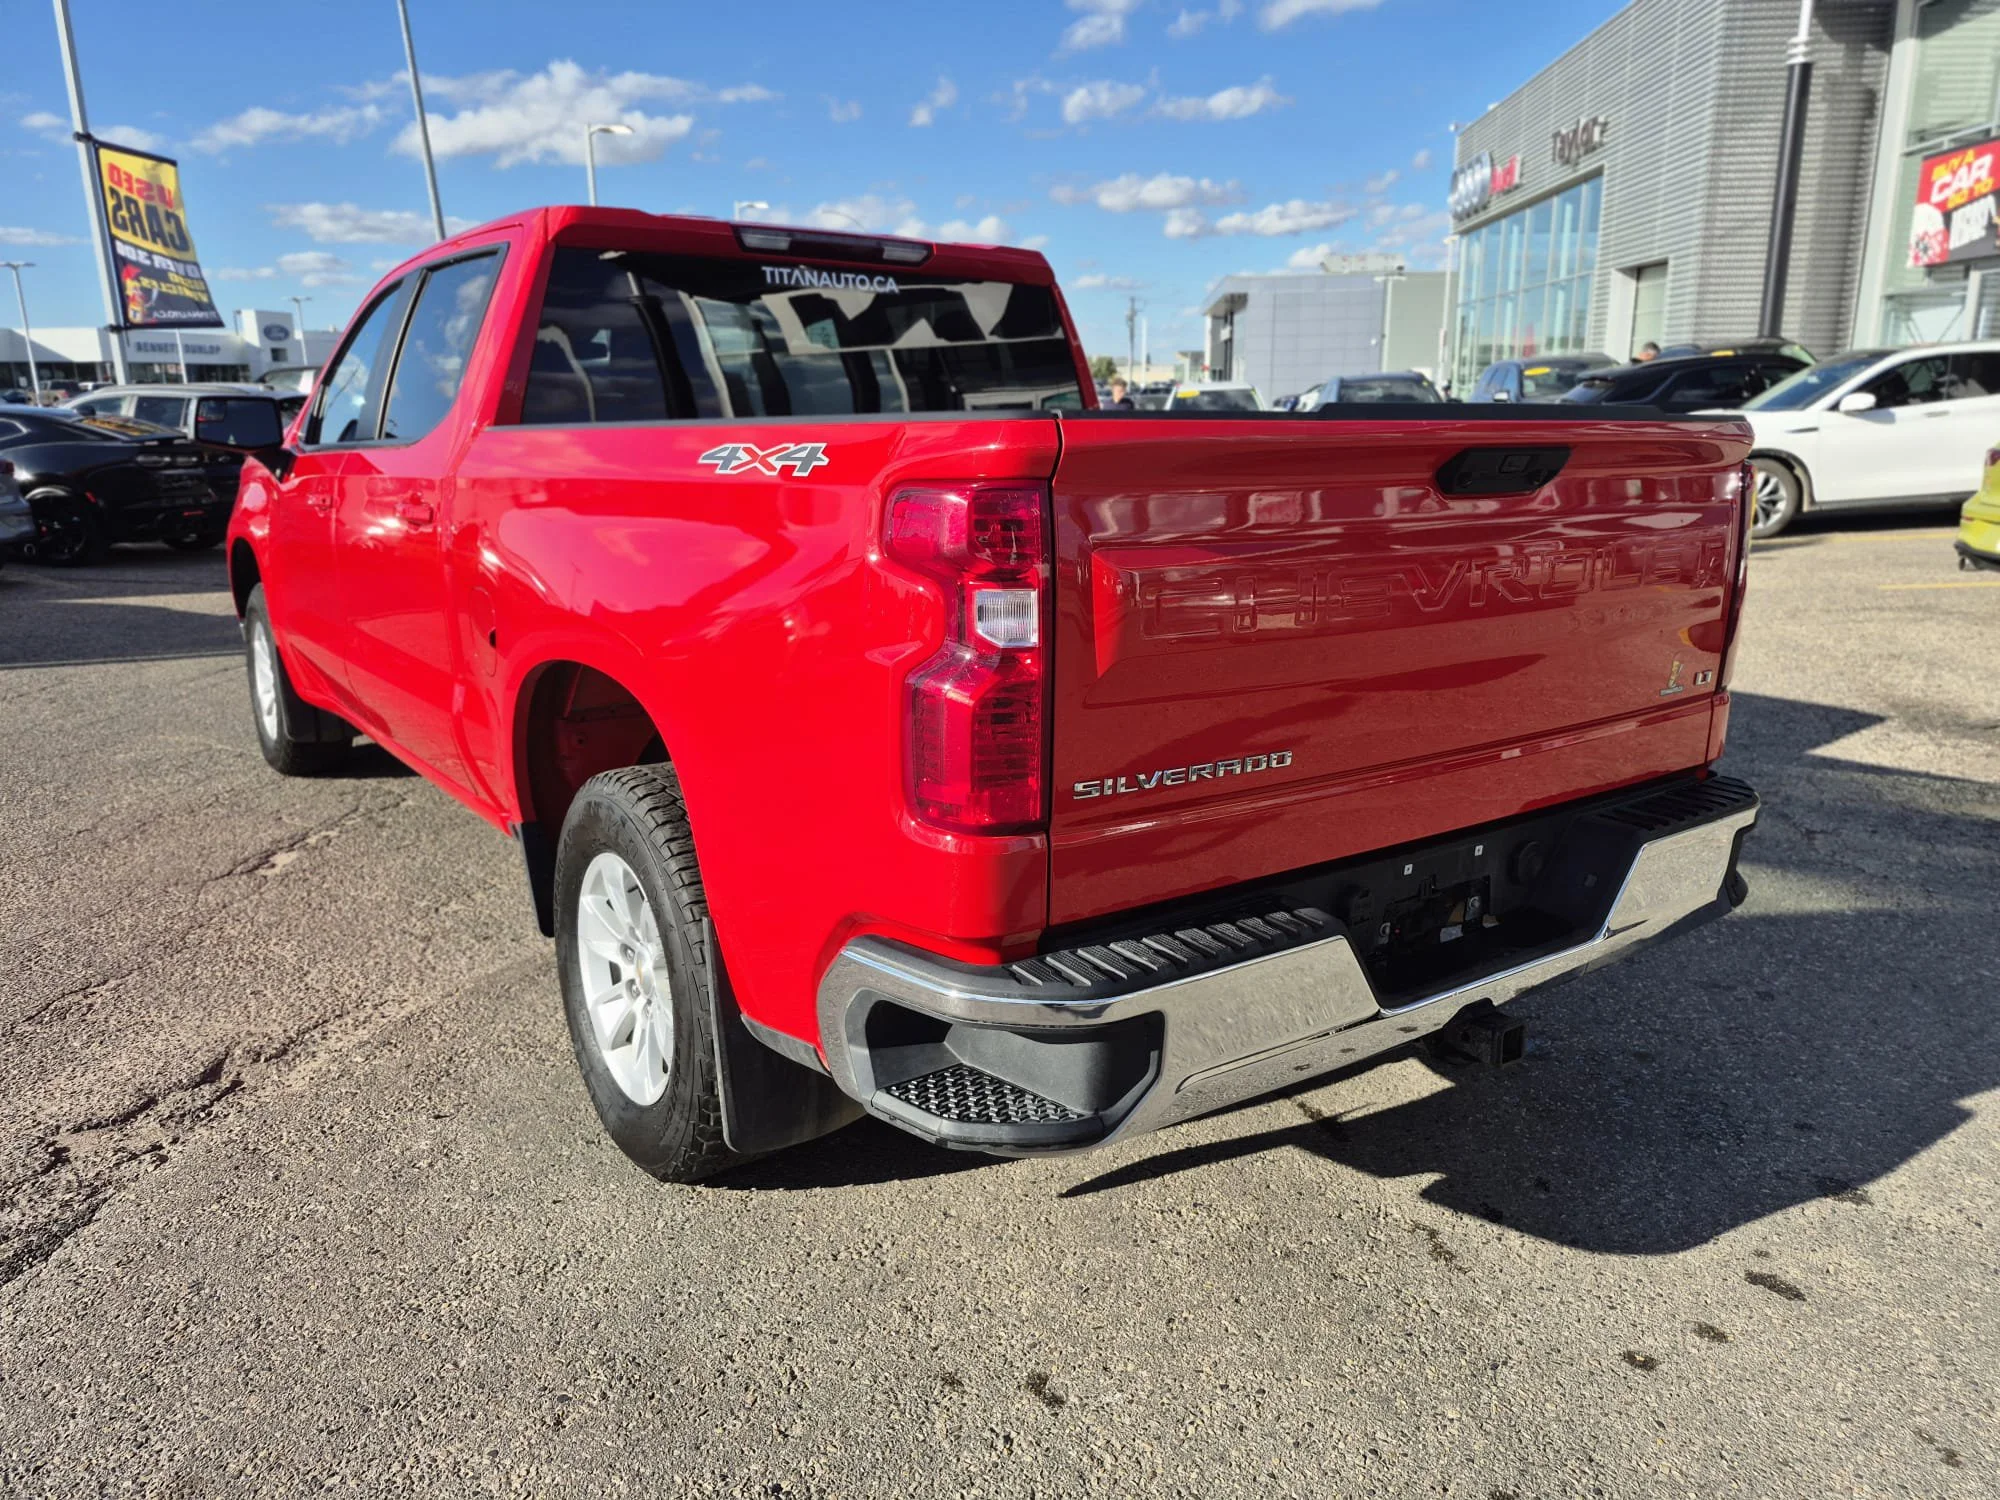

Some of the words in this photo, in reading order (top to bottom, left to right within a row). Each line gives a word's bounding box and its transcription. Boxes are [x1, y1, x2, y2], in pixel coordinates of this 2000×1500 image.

[1930, 154, 1993, 204] CAR
[761, 266, 900, 294] TITANAUTO.CA
[1073, 750, 1293, 800] SILVERADO
